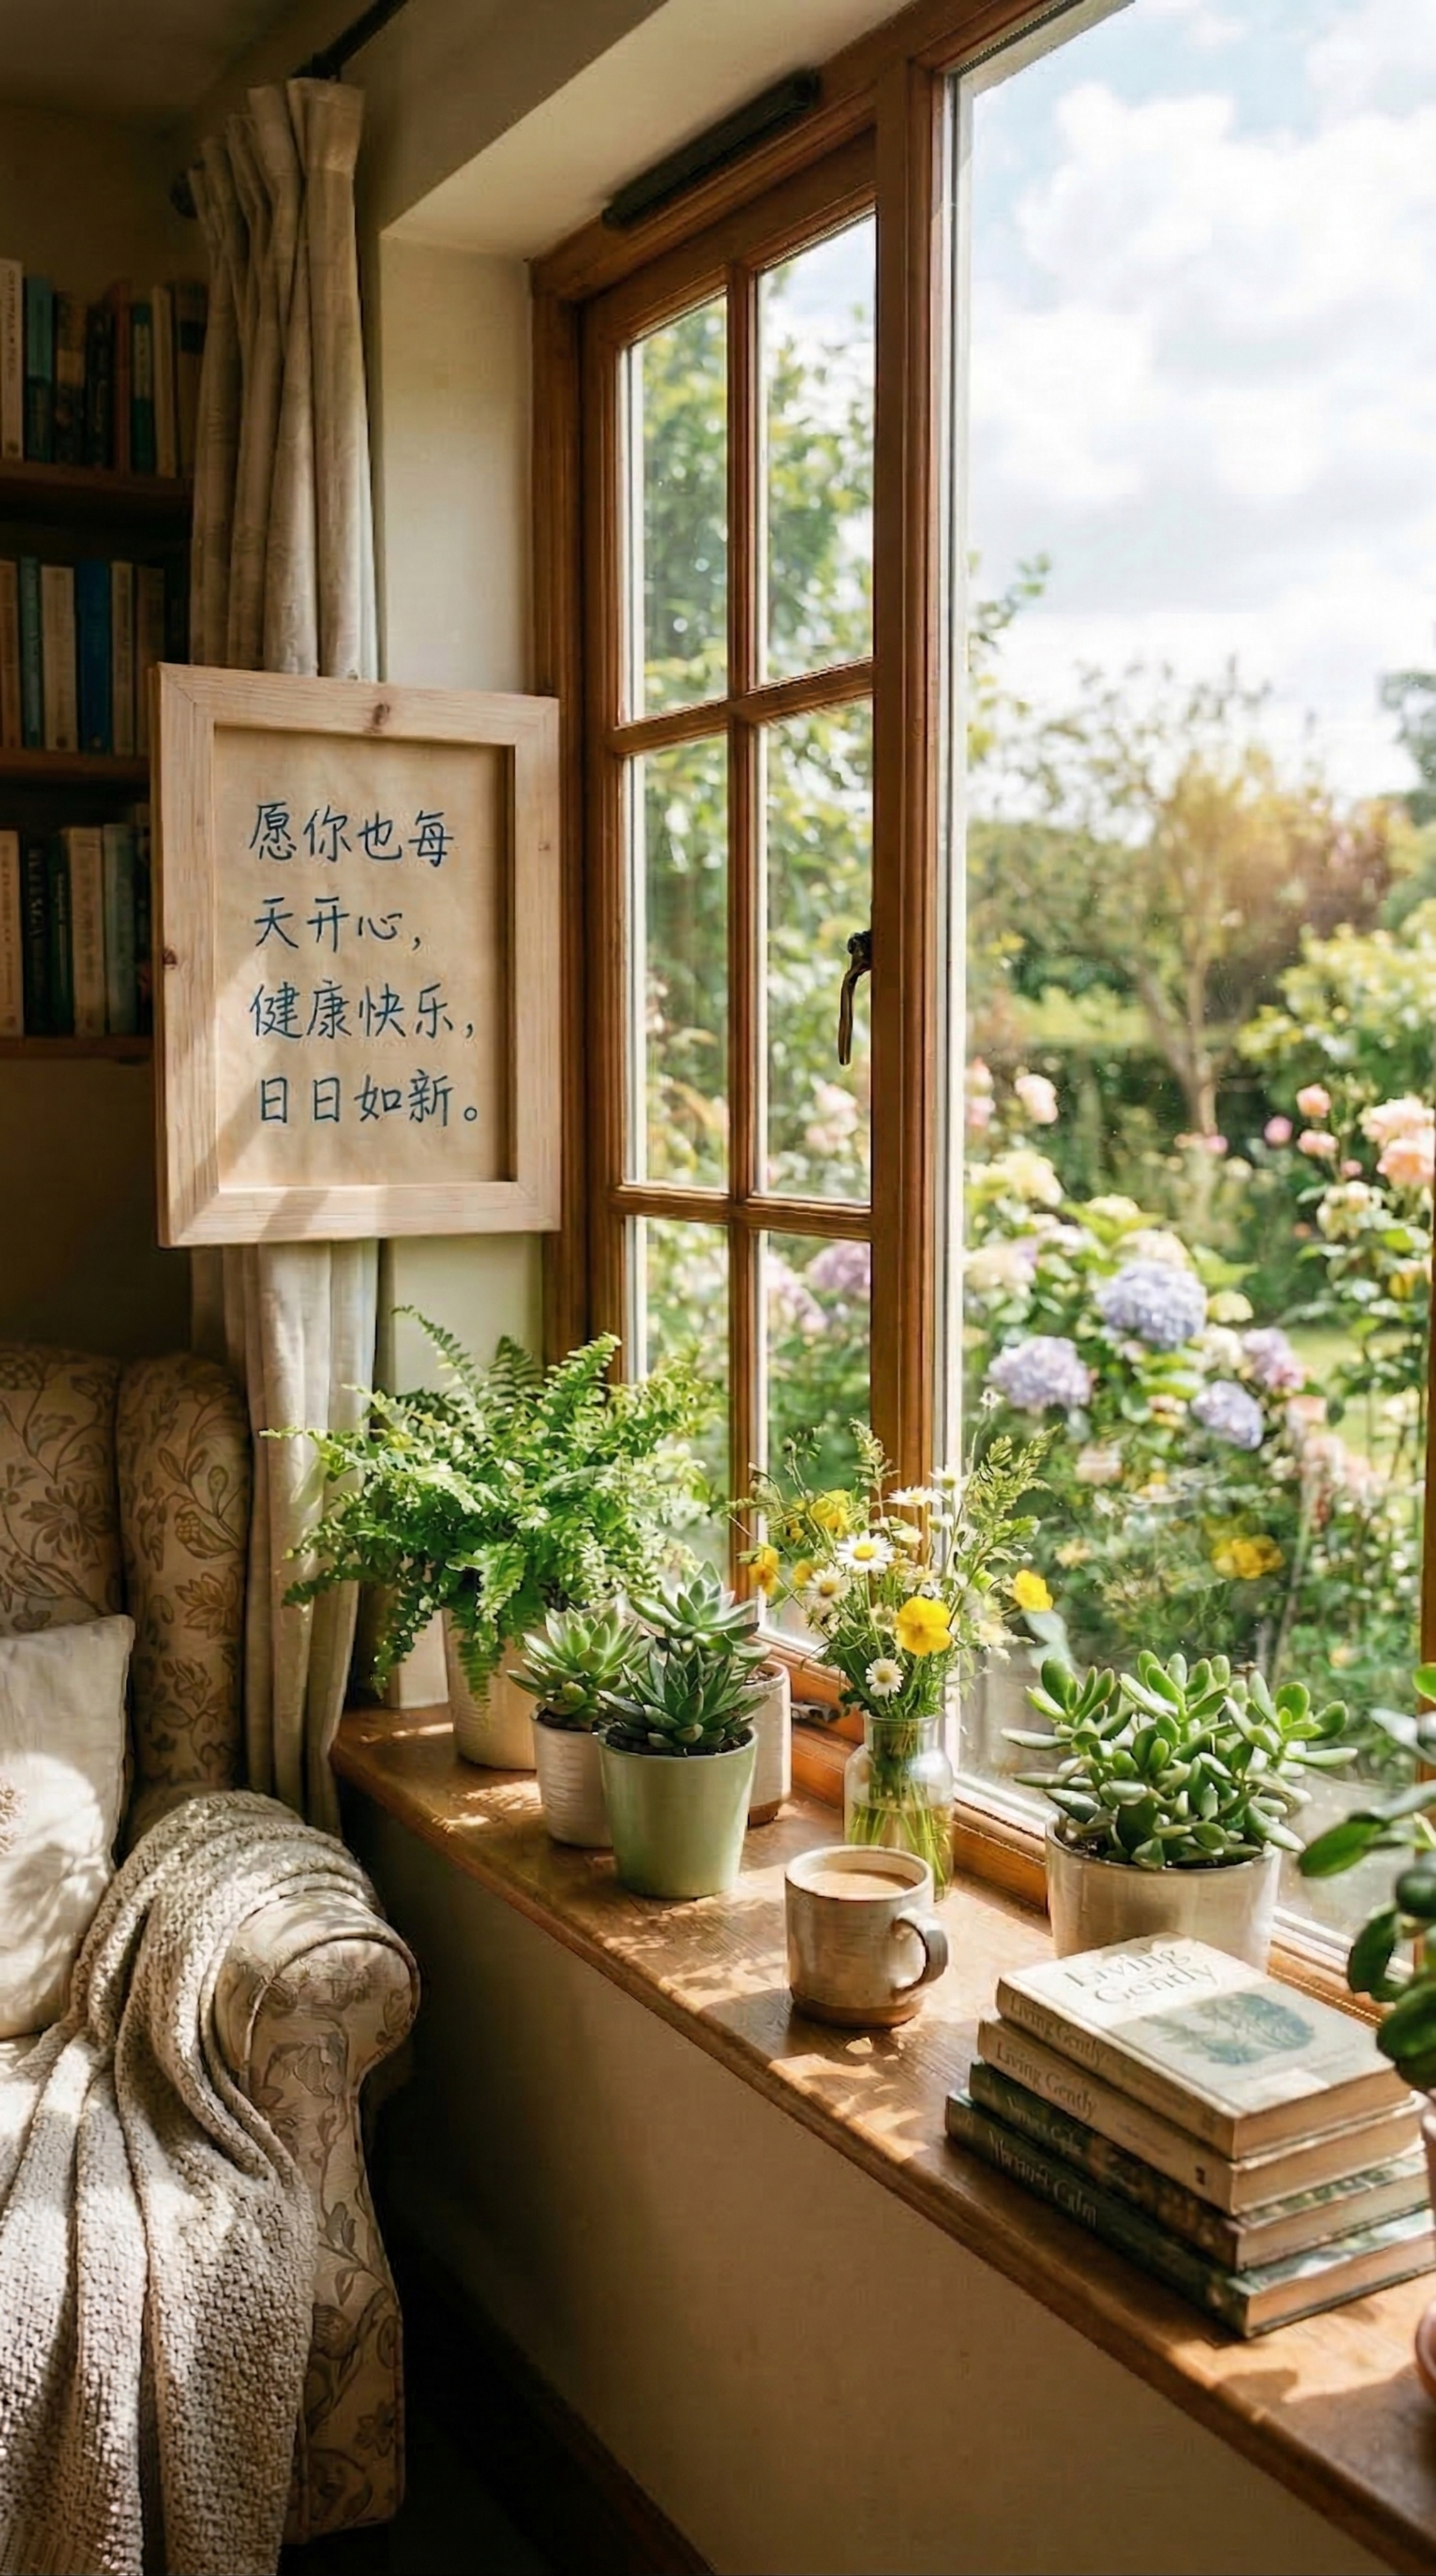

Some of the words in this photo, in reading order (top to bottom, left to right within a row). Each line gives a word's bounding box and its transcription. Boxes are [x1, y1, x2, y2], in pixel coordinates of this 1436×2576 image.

[250, 801, 454, 868] 愿你也每
[254, 897, 422, 952] 天开心，
[249, 980, 474, 1040] 健康快乐，
[260, 1069, 478, 1127] 日日如新。
[1063, 1950, 1191, 1987] Living
[1094, 1964, 1218, 2004] Gently
[1010, 1994, 1054, 2039] Living
[1056, 2023, 1105, 2068] Gently
[997, 2041, 1041, 2089] Living
[1046, 2072, 1096, 2119] Gently
